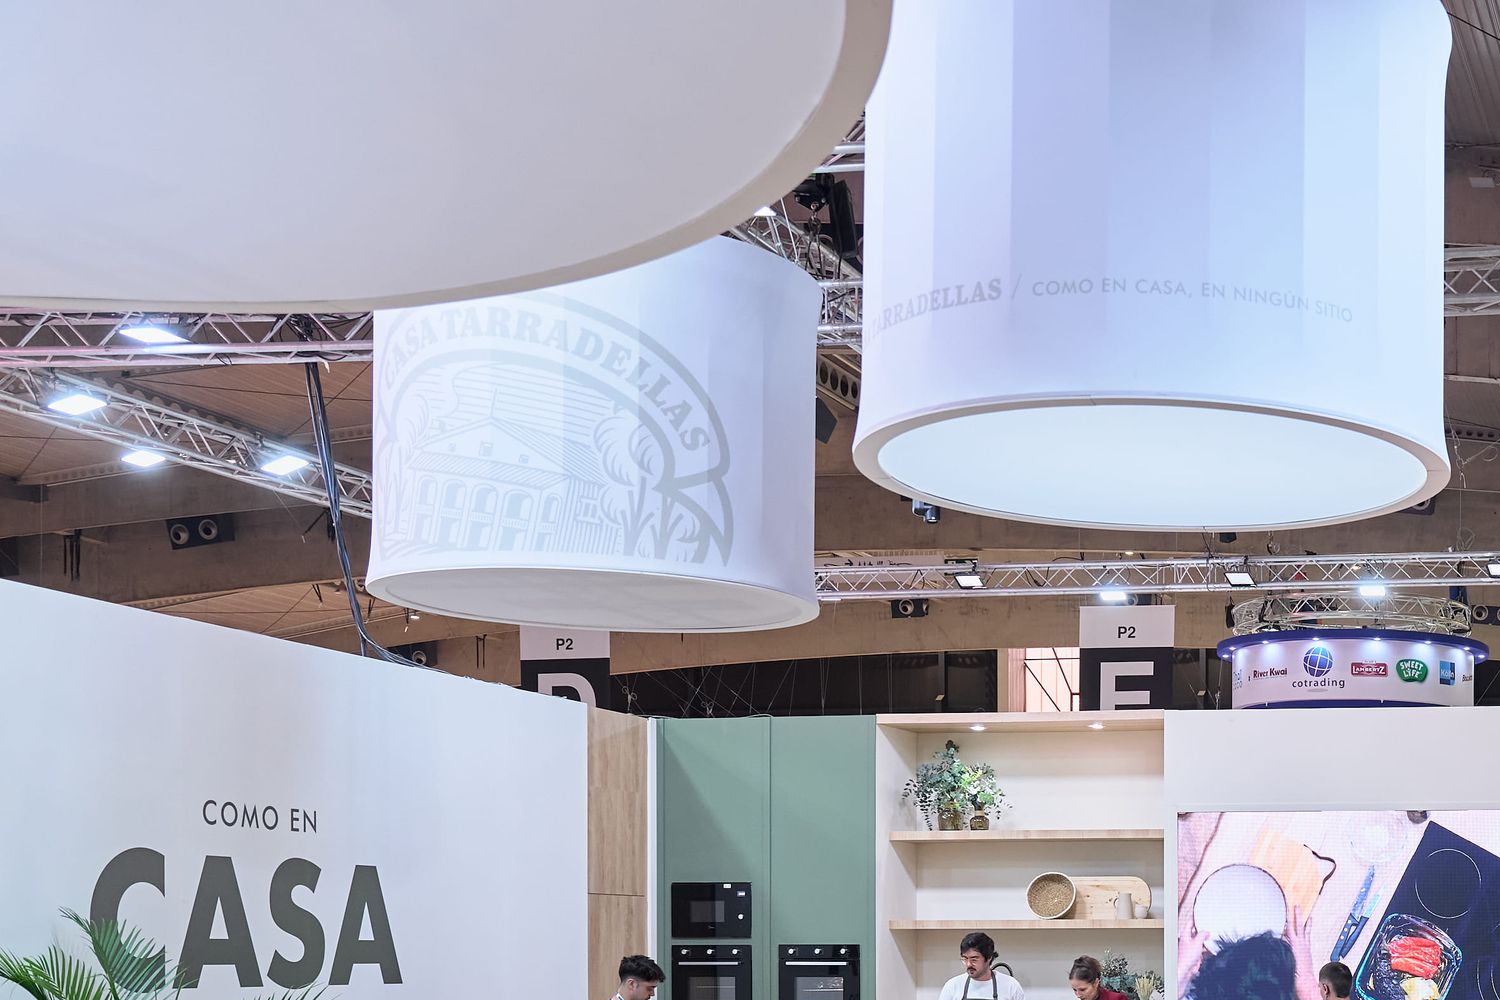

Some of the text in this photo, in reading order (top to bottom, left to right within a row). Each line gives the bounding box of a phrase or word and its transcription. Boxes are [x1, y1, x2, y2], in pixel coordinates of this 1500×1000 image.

[1032, 279, 1094, 297] COMO
[1101, 278, 1127, 293] EN
[1135, 278, 1193, 299] CASA,
[1201, 282, 1225, 298] EN
[1233, 286, 1309, 311] NINGÚN
[1315, 300, 1353, 323] SITIO
[384, 306, 711, 451] CASA TARRADELLAS
[1117, 626, 1136, 639] P2
[556, 638, 574, 651] P2
[1400, 661, 1423, 670] SWEET
[1253, 669, 1268, 679] River
[1269, 668, 1288, 676] Kwai
[1292, 678, 1345, 688] cotrading
[203, 799, 317, 833] COMO EN
[90, 846, 403, 993] CASA
